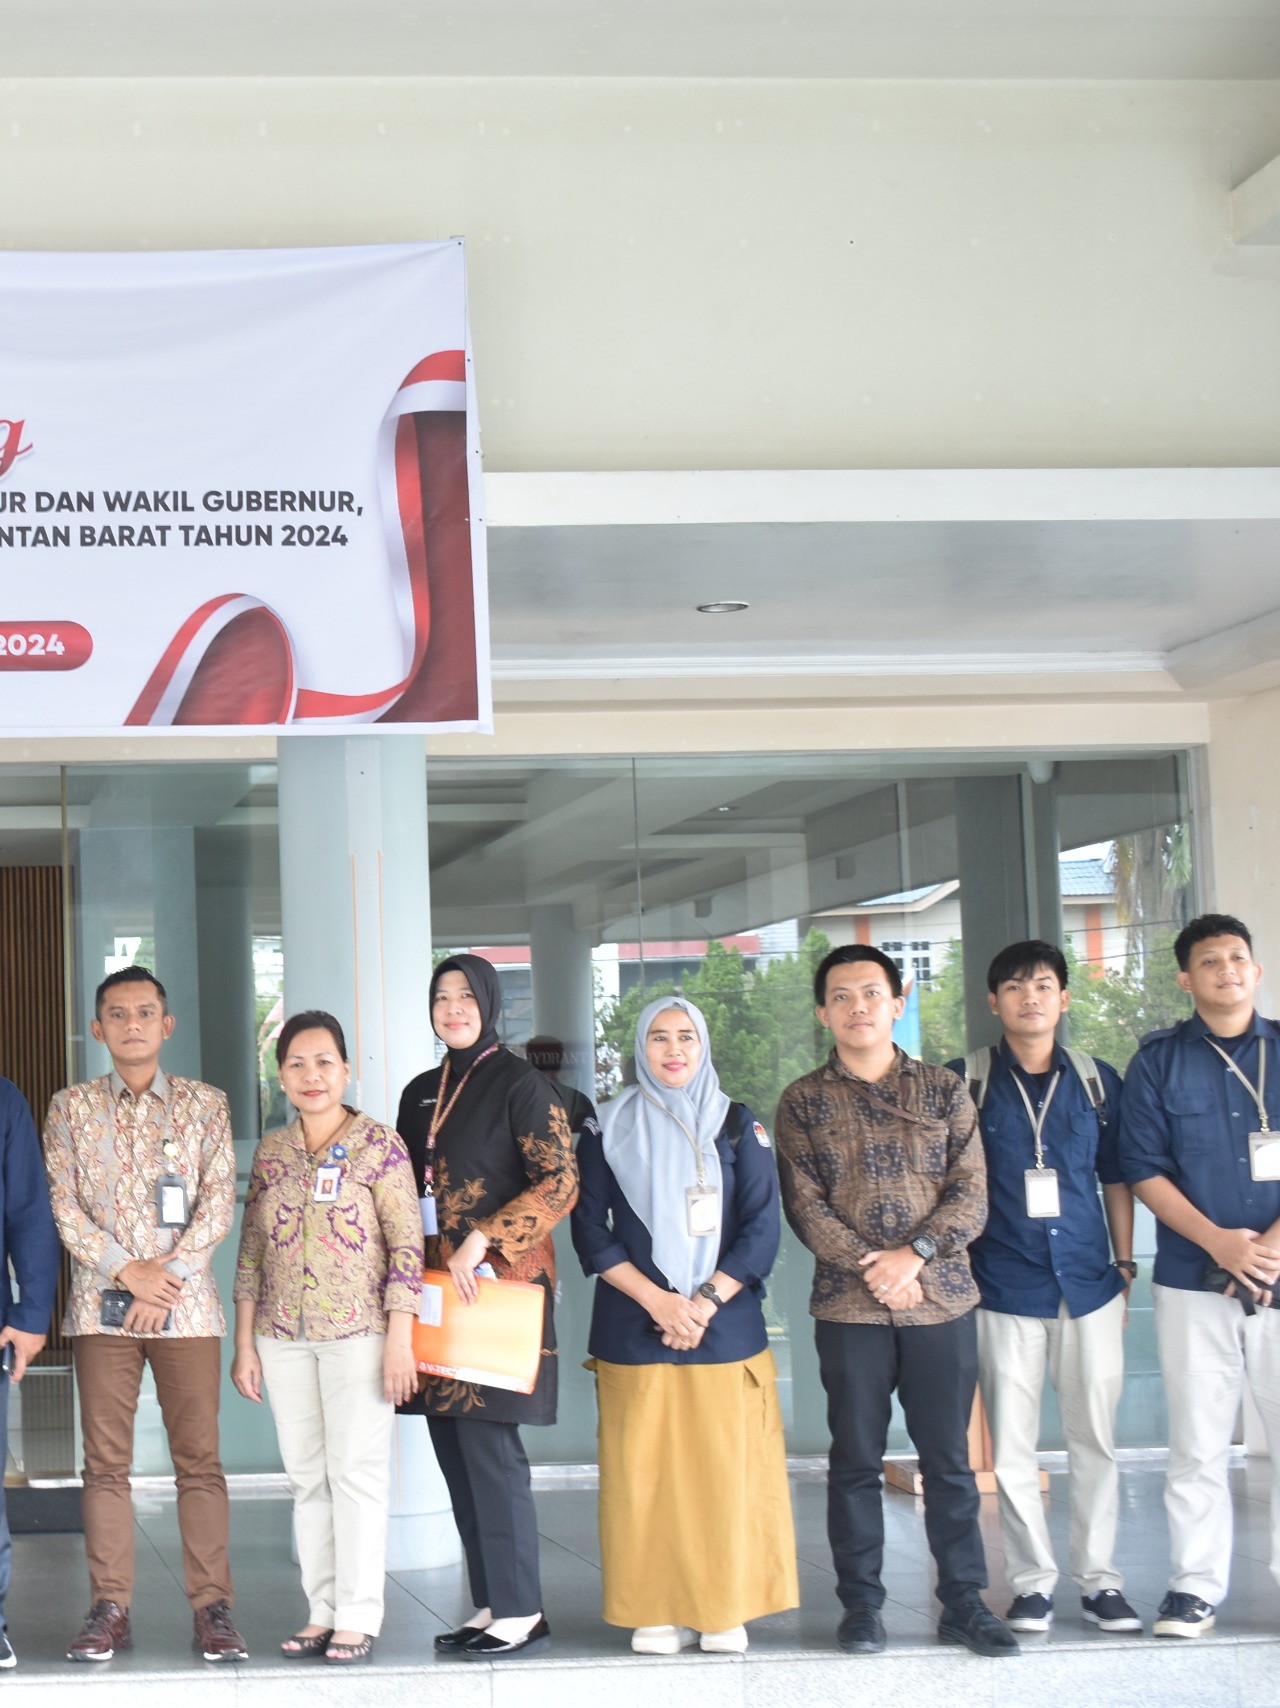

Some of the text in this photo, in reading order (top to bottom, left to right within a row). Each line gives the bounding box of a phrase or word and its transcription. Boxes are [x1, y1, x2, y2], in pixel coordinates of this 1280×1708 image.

[35, 491, 95, 513] DAN
[102, 490, 195, 512] WAKIL
[202, 490, 363, 517] GUBERNUR,
[79, 525, 172, 547] BARAT
[178, 524, 273, 547] TAHUN
[281, 524, 349, 547] 2024
